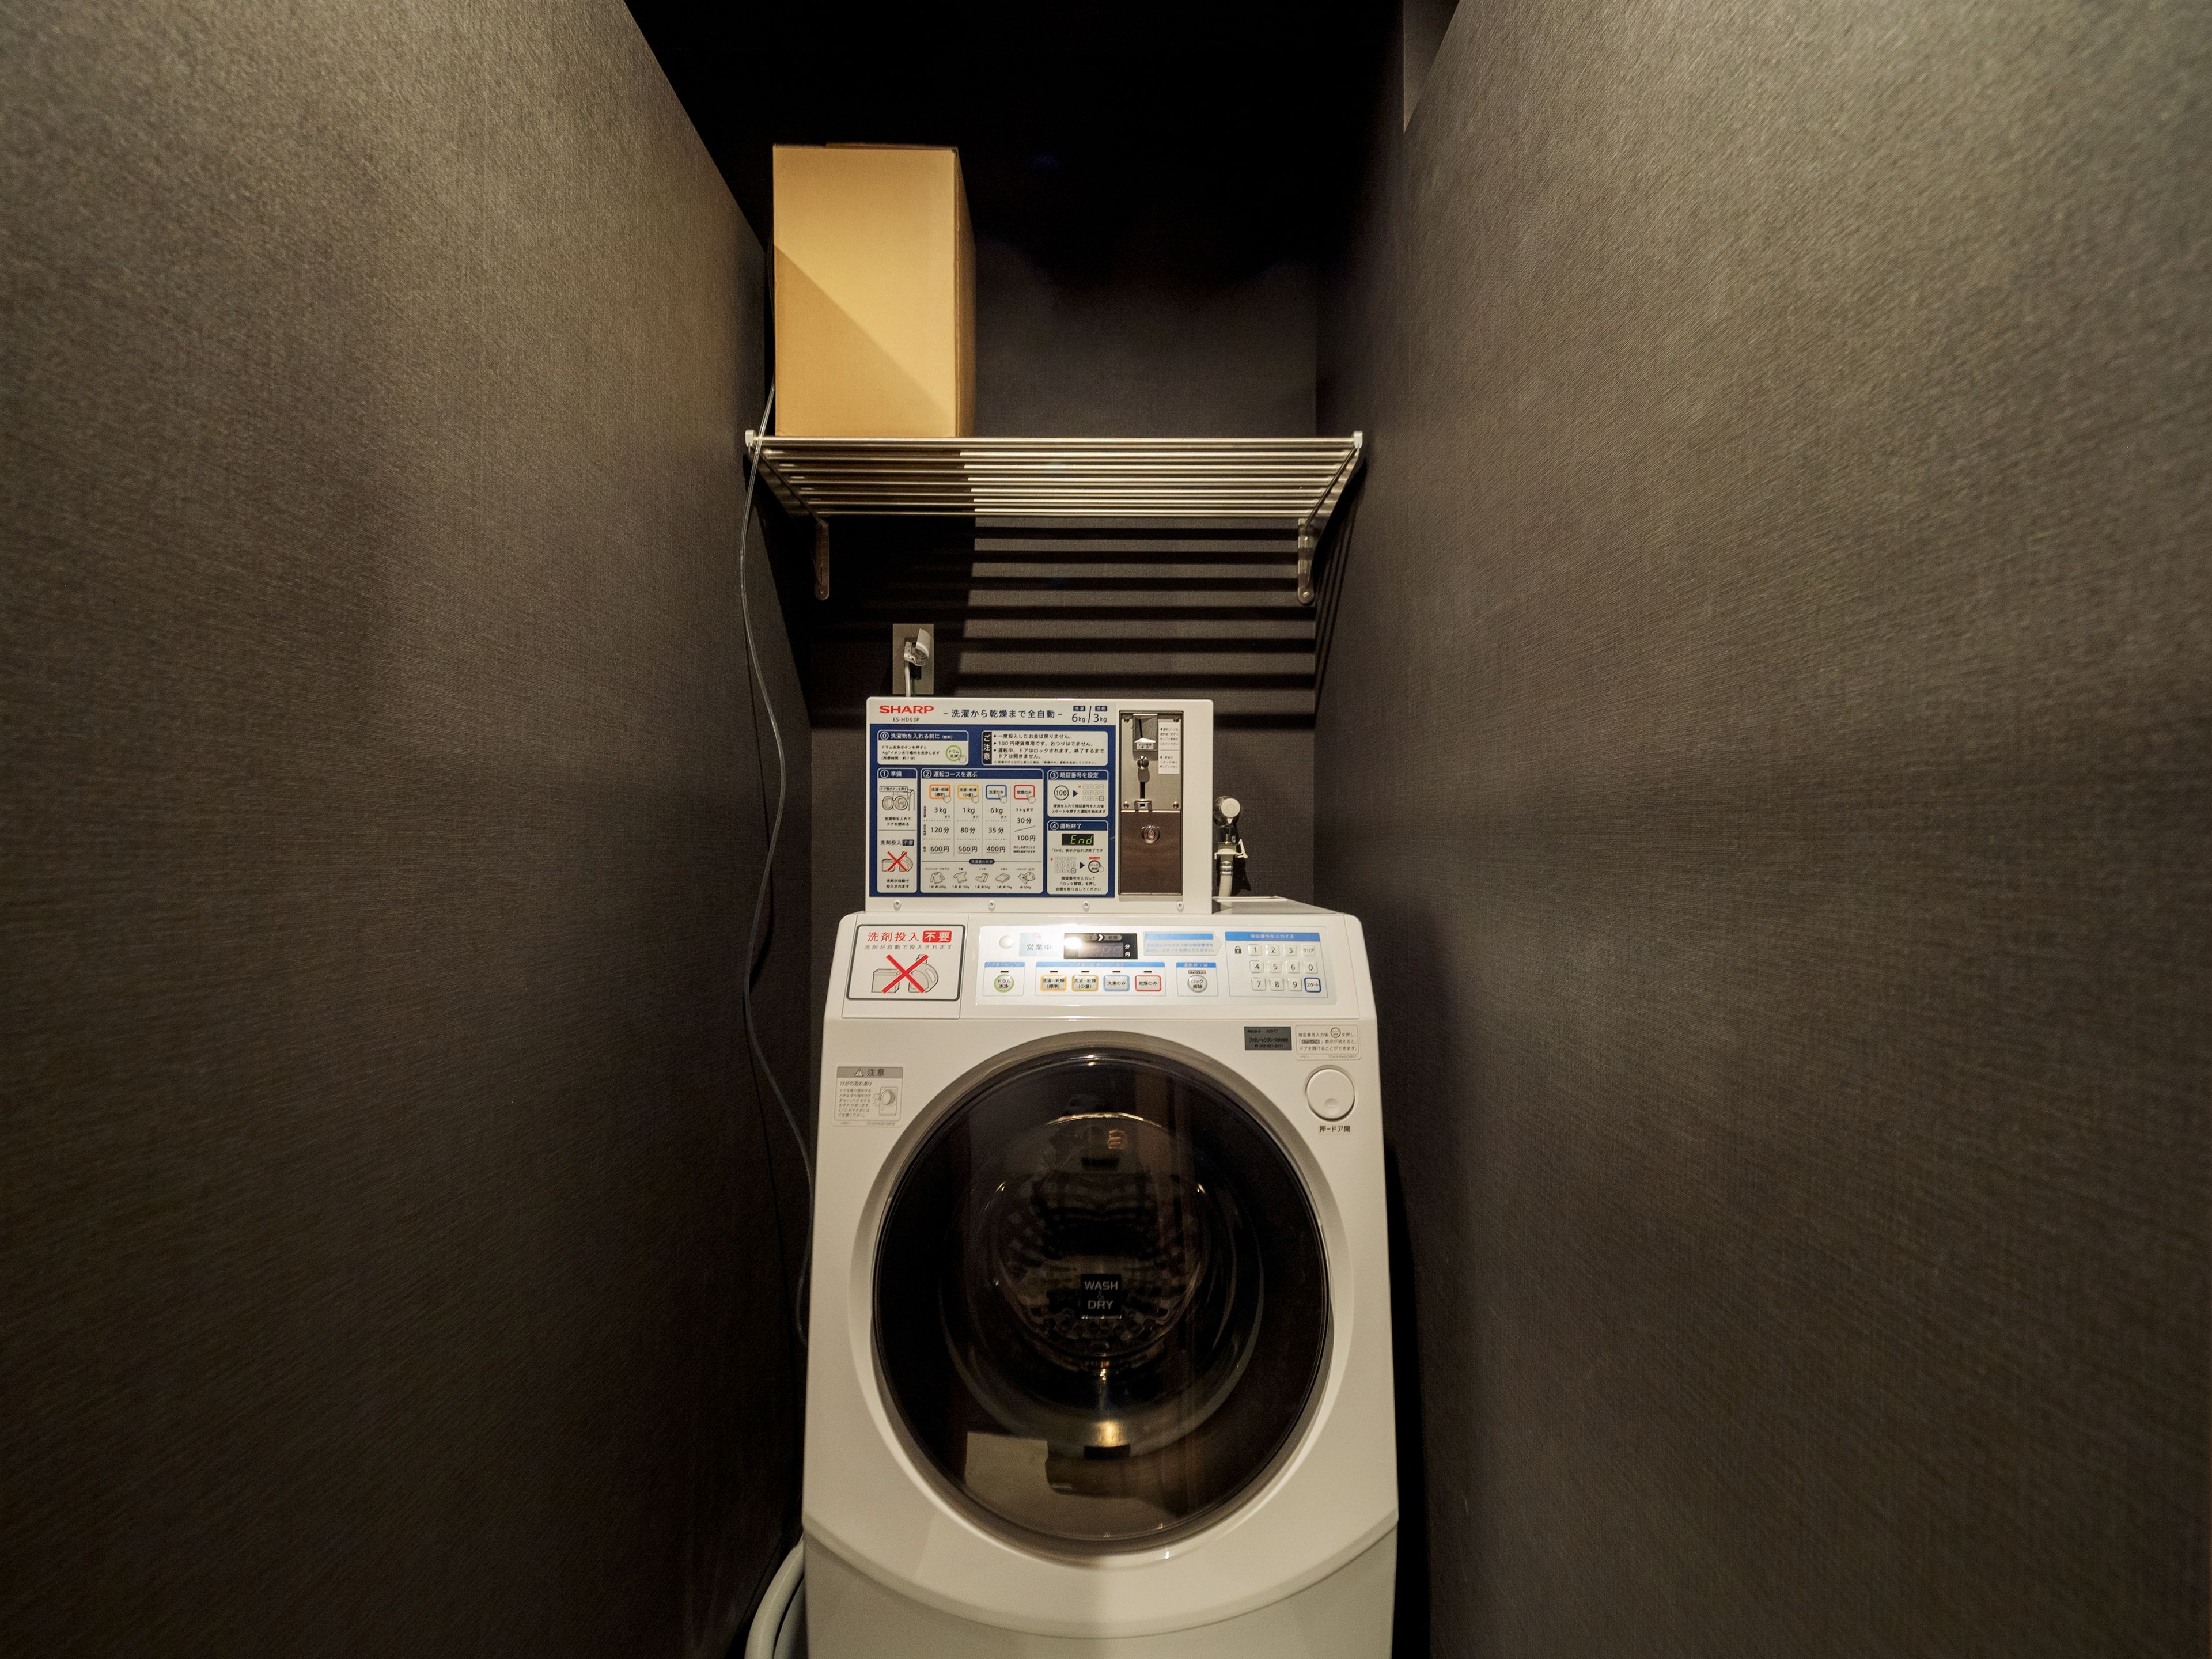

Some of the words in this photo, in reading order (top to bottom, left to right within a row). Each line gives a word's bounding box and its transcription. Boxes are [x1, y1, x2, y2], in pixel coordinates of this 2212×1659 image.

[879, 706, 934, 714] SHARP
[1071, 714, 1086, 722] 6kg
[1093, 714, 1107, 722] 3kg
[1070, 835, 1093, 844] End
[866, 931, 919, 942] 洗剤投入
[924, 931, 951, 942] 不要
[867, 1069, 885, 1077] 注意
[1084, 1281, 1118, 1290] WASH
[1088, 1300, 1113, 1309] DRY
